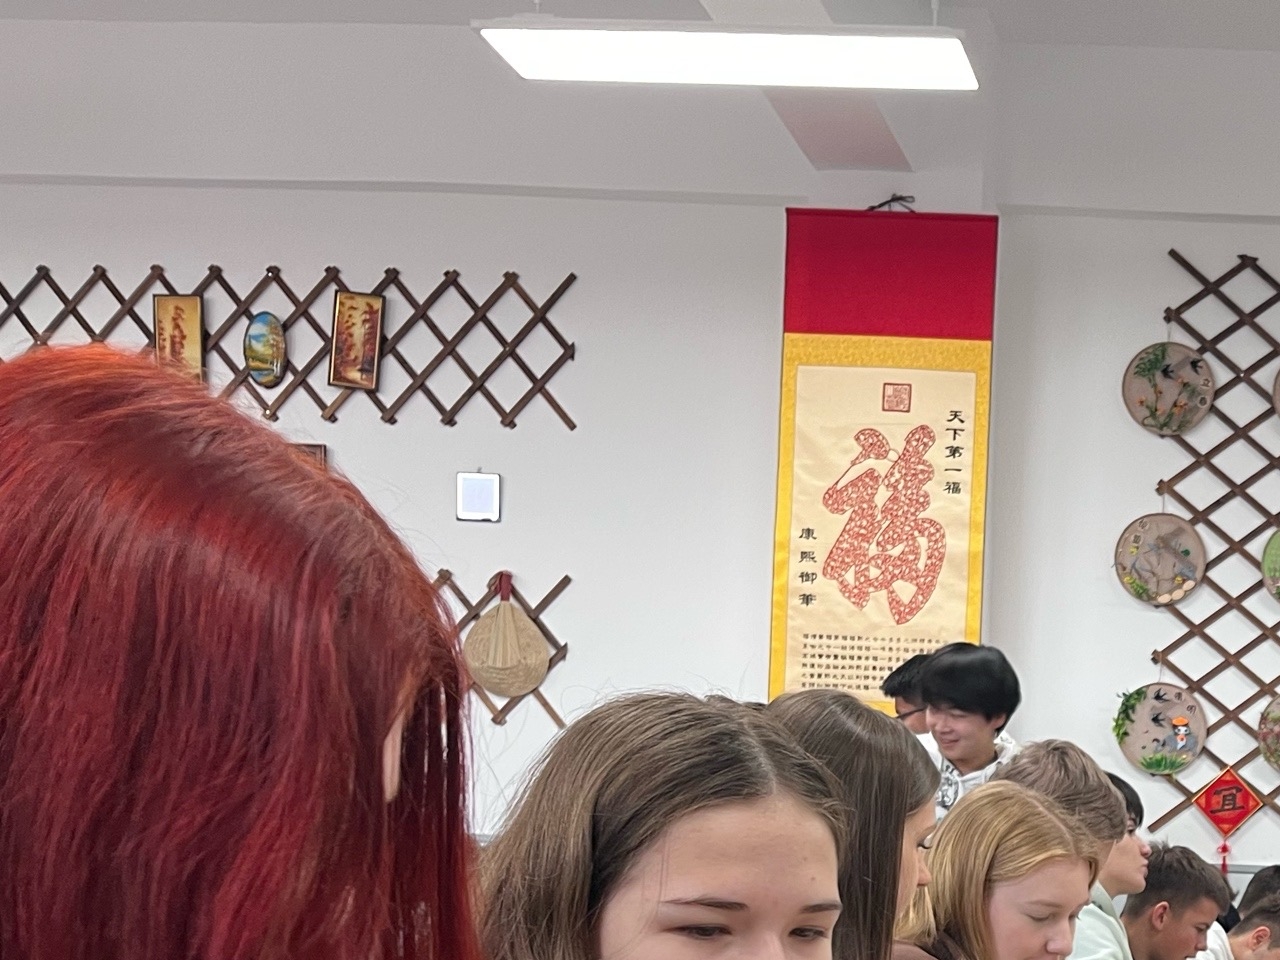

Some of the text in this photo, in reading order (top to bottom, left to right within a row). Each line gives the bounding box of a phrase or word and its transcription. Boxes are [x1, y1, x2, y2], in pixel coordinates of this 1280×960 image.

[943, 410, 965, 494] 天下第一福
[822, 424, 946, 625] 福
